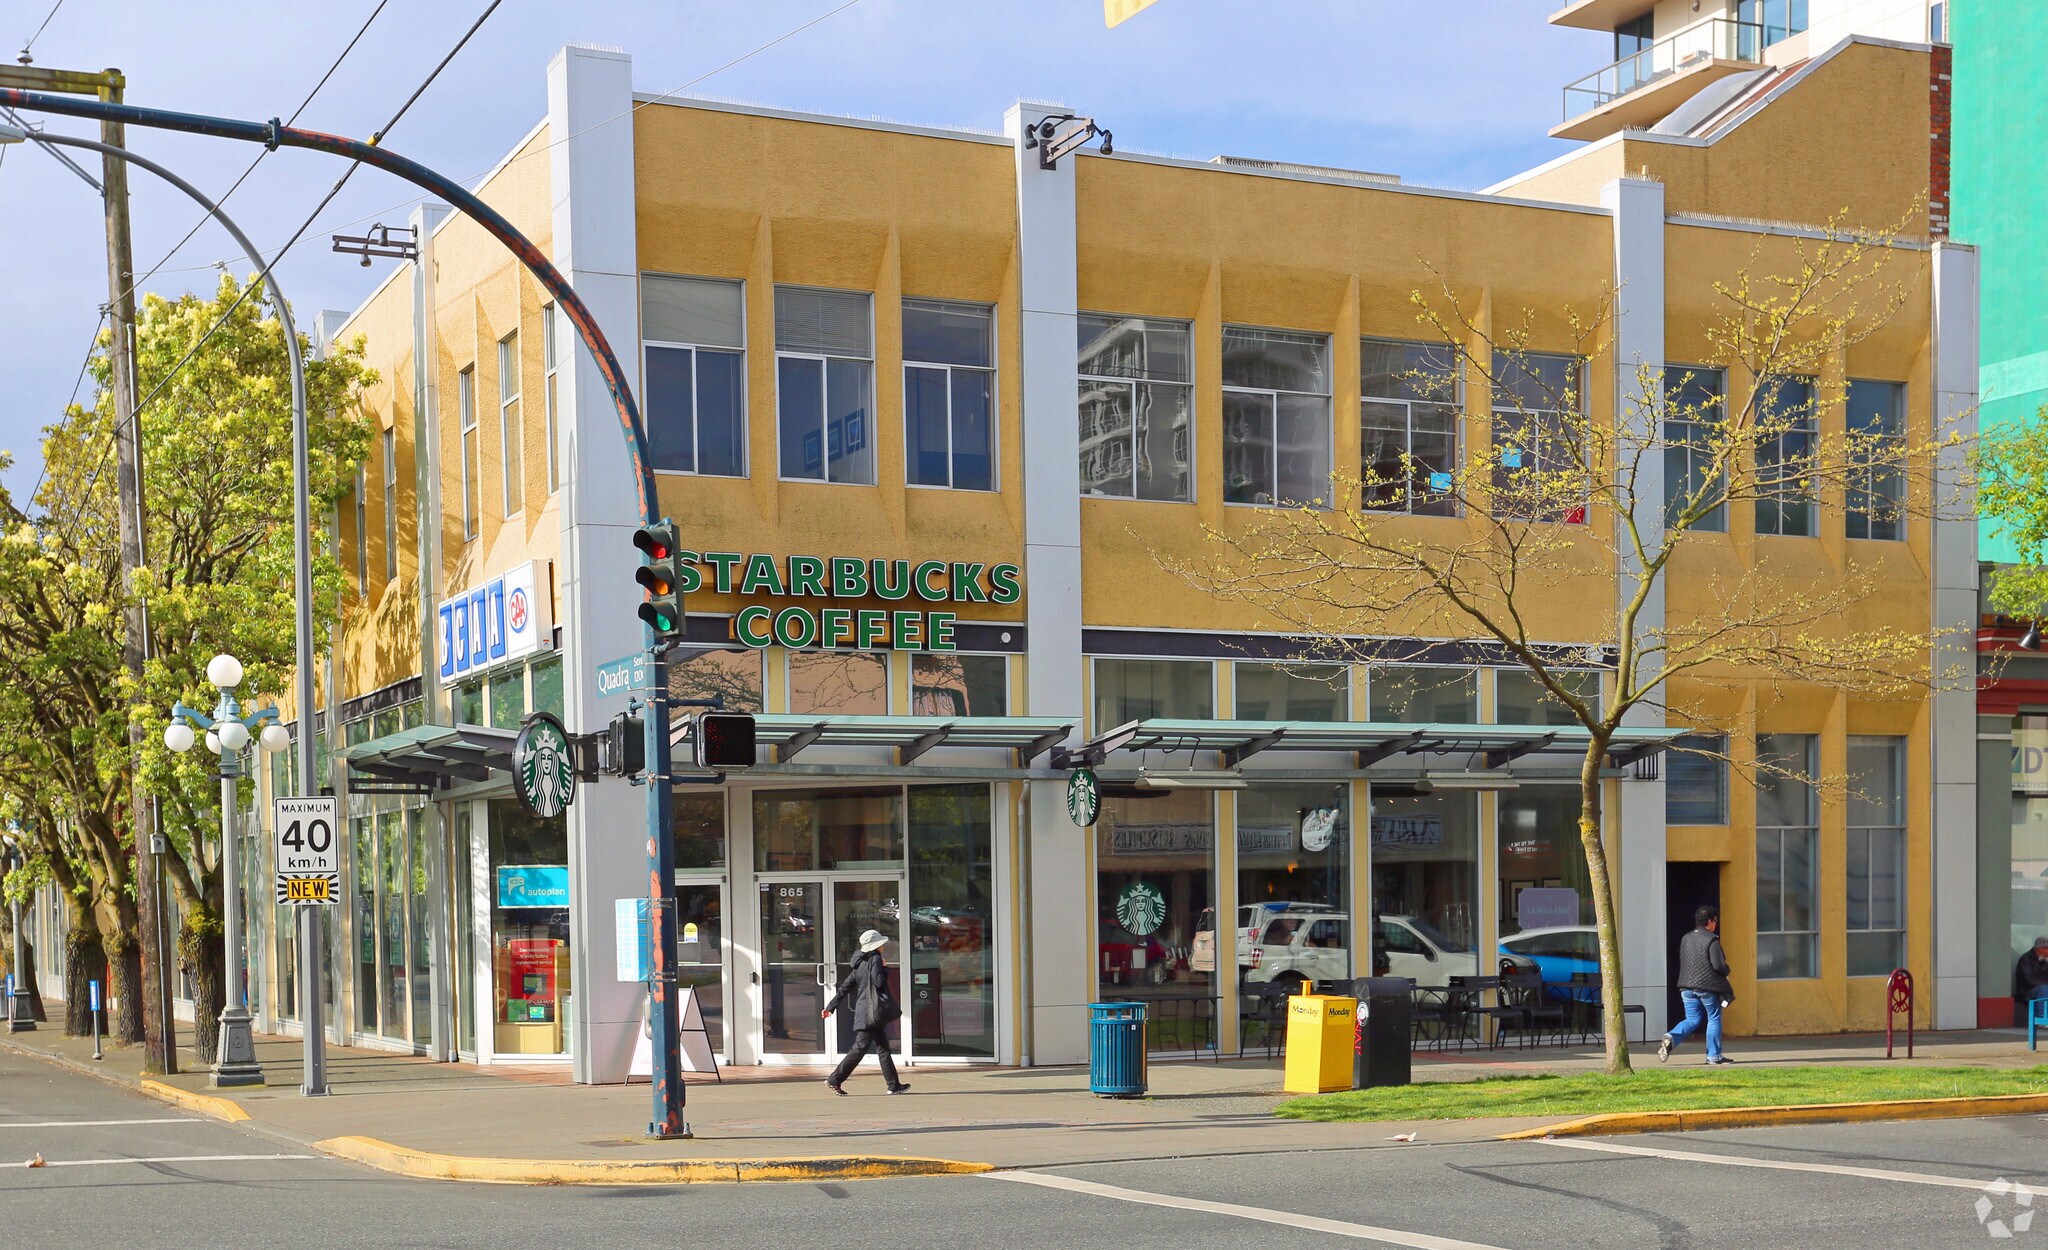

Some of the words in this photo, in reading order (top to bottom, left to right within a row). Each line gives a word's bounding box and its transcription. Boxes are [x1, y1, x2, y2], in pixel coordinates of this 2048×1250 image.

[681, 551, 1022, 604] STARBUCKS
[511, 594, 526, 627] CAA
[440, 591, 501, 667] BCAA
[736, 606, 957, 651] COFFEE
[598, 665, 629, 695] Quadra
[281, 804, 331, 813] MAXIMUM
[282, 819, 331, 853] 40
[288, 856, 327, 868] km/h
[291, 881, 325, 897] NEW
[527, 887, 566, 897] autoplan
[779, 887, 804, 897] 865
[1292, 1005, 1319, 1017] Monday
[1328, 1007, 1351, 1018] Monday
